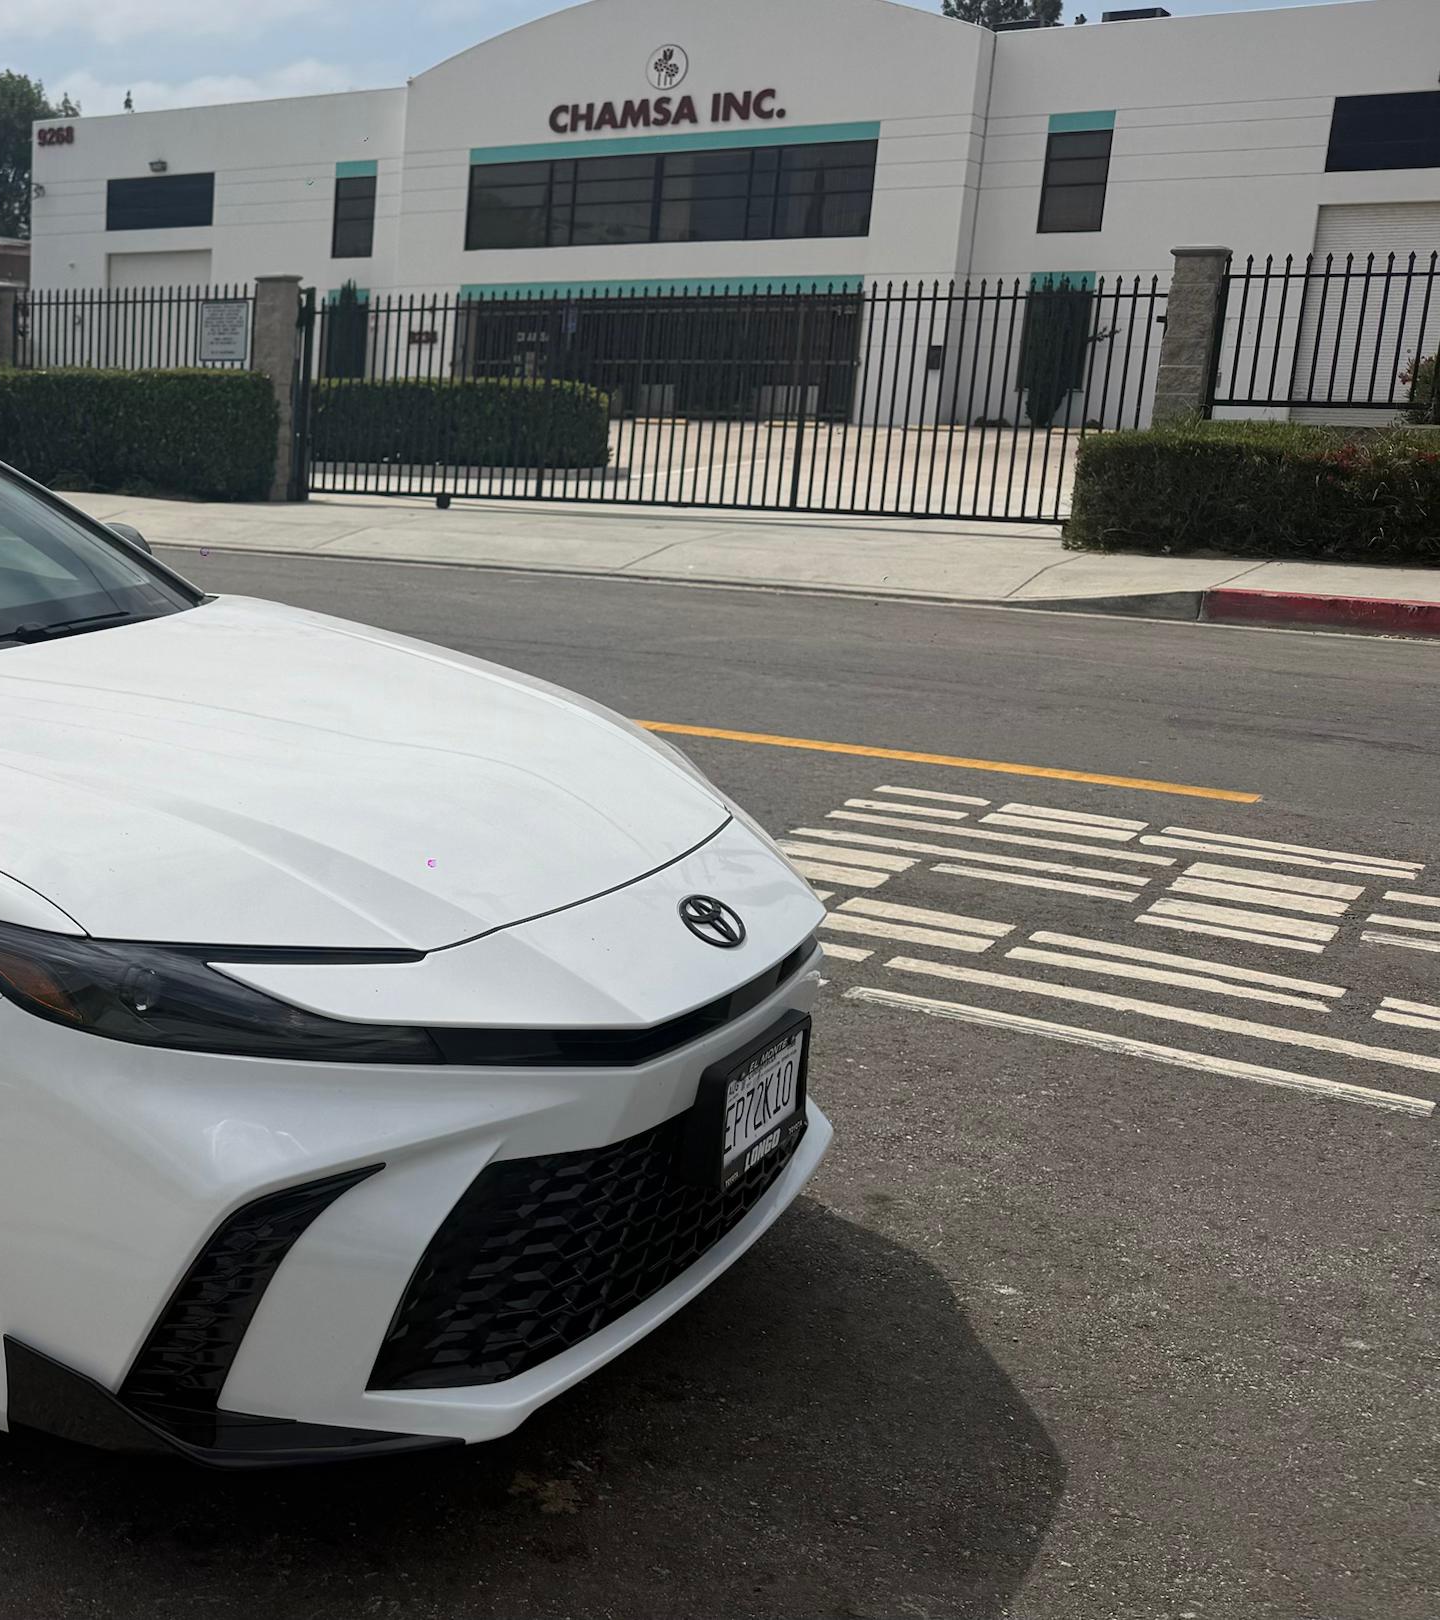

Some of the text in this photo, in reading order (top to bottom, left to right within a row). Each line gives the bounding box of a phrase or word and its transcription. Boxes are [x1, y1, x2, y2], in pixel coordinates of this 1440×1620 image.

[548, 88, 787, 134] CHAMSA INC.
[724, 1060, 794, 1155] EP72K10
[744, 1127, 781, 1173] LONGO
